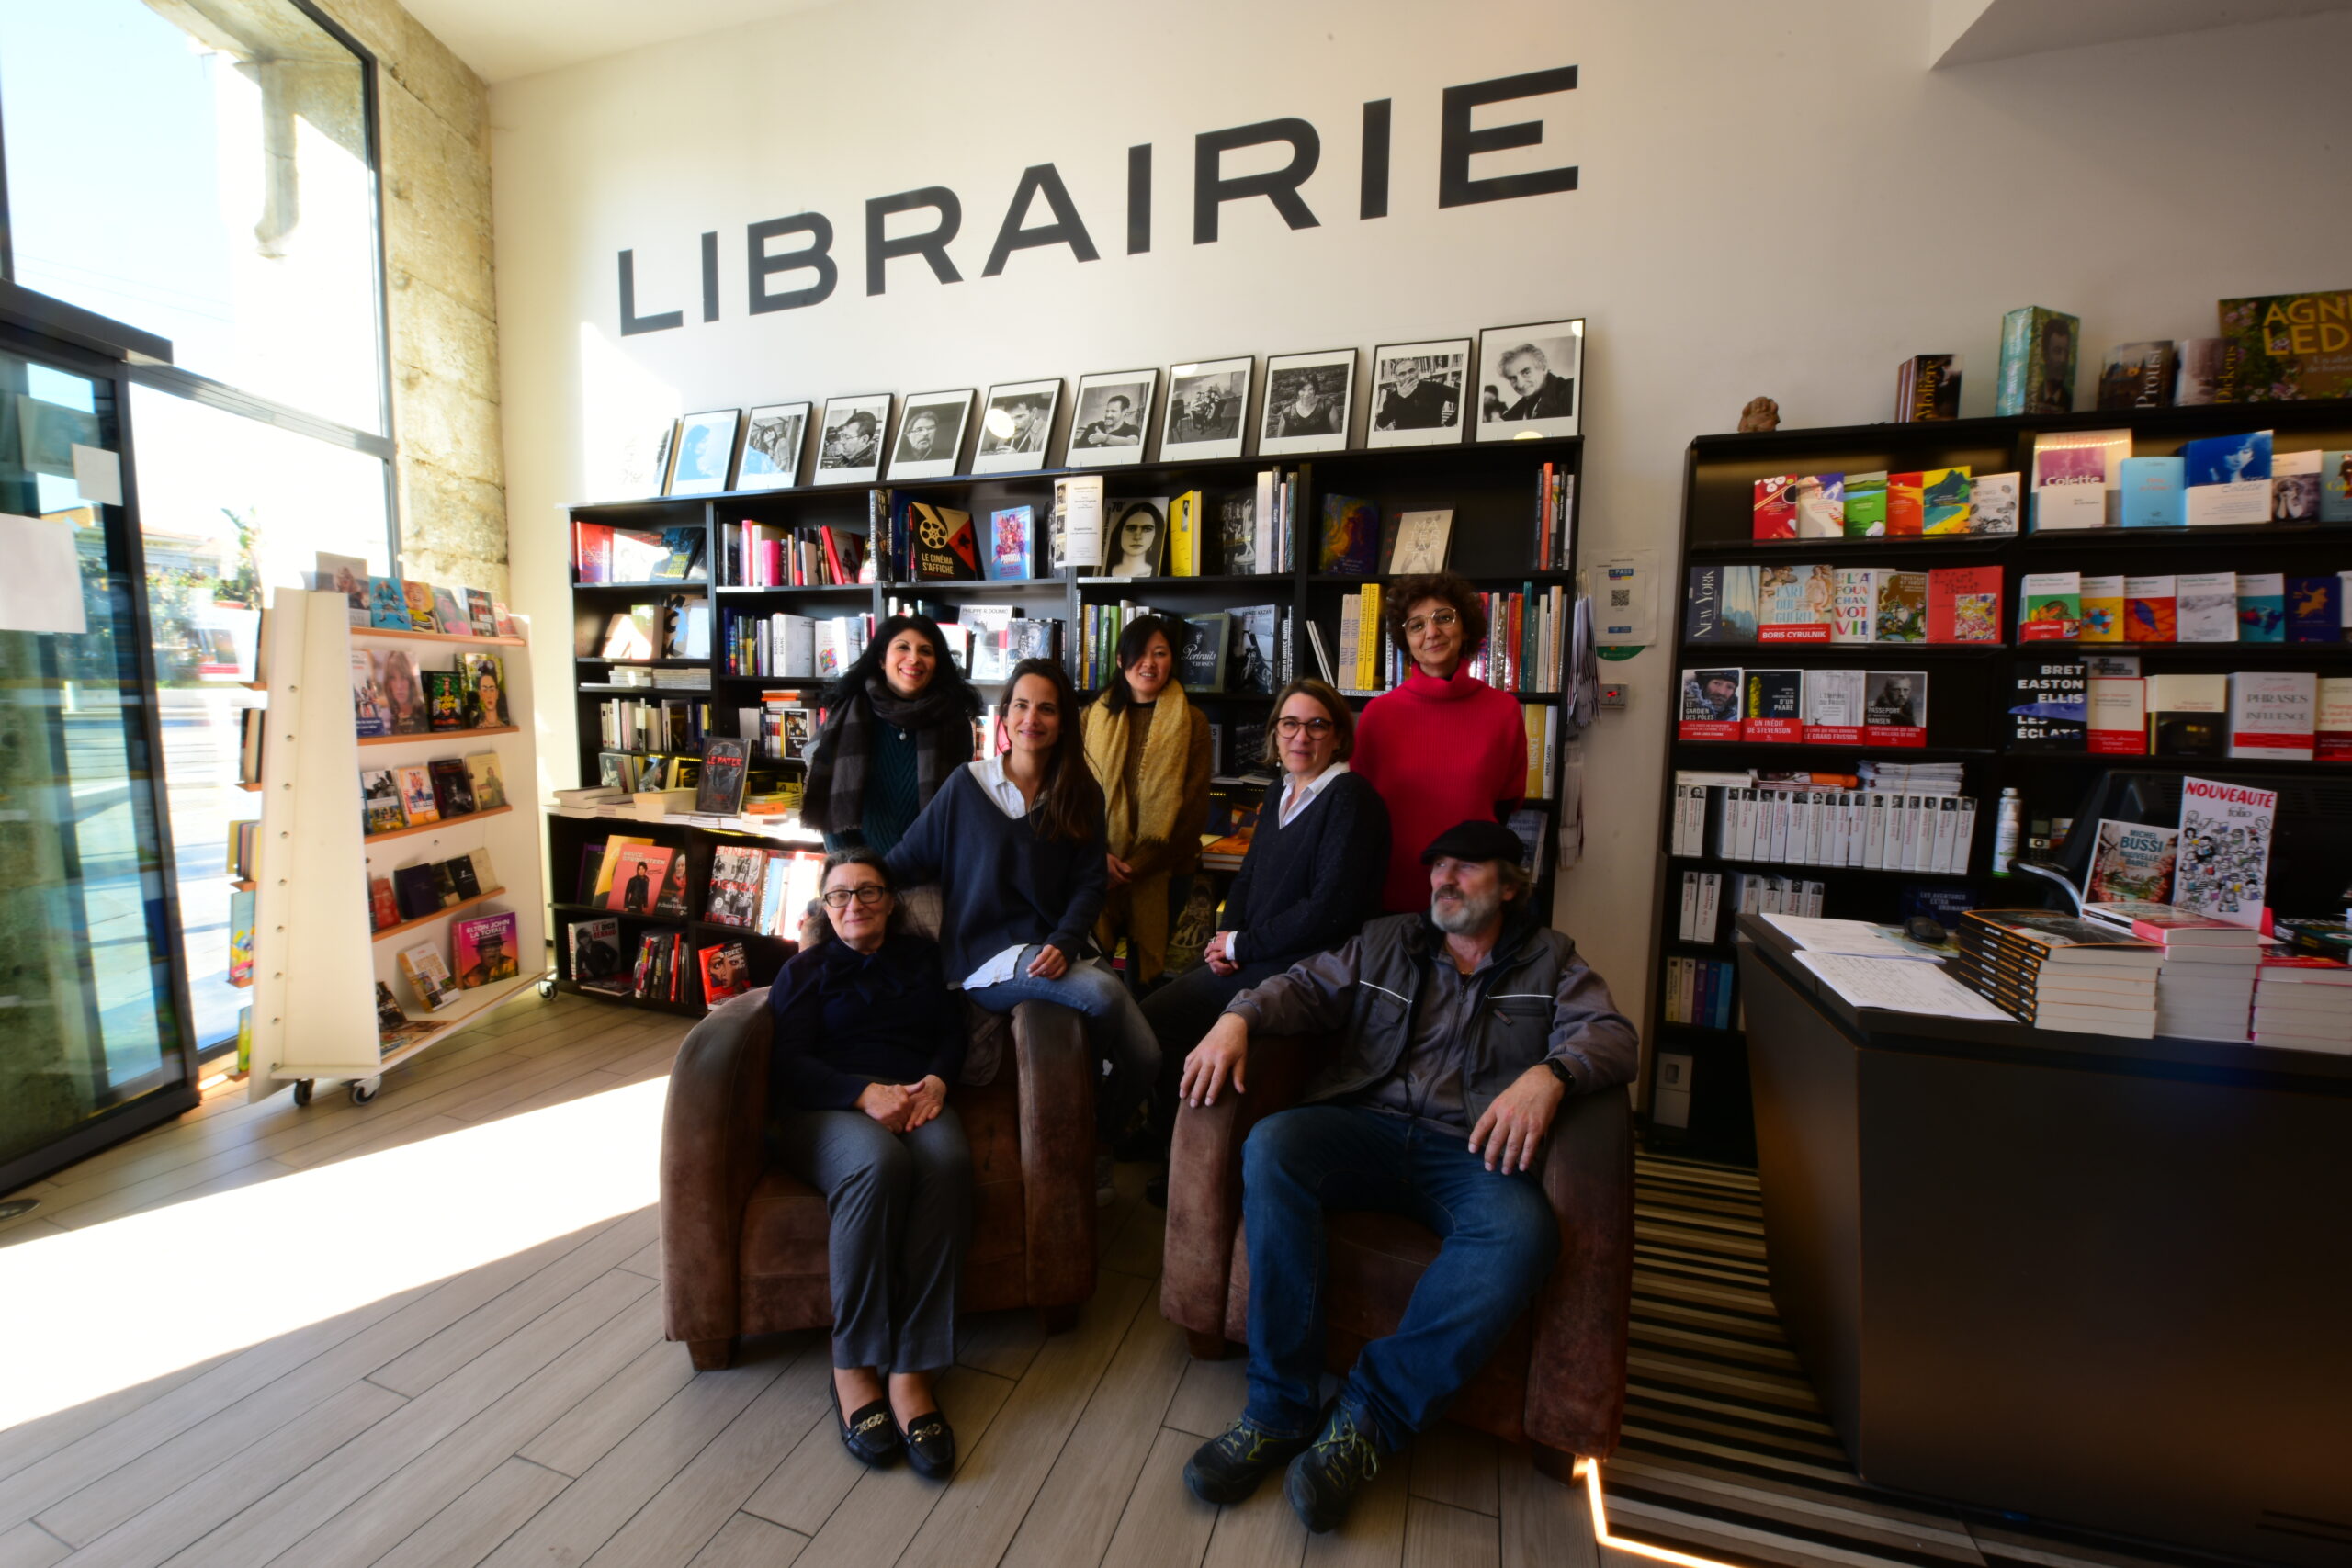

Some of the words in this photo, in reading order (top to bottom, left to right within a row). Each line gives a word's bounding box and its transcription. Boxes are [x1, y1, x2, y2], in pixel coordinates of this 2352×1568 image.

[617, 64, 1579, 337] LIBRAIRIE
[2263, 292, 2352, 327] AGN
[2135, 349, 2163, 408] Proust
[2214, 345, 2237, 404] Dickens
[2046, 474, 2101, 486] Colette
[922, 552, 929, 562] LE
[930, 553, 953, 565] CINÉMA
[922, 562, 954, 575] S'AFFICHE
[1695, 570, 1715, 604] YORK
[1693, 609, 1713, 637] NEW
[1762, 631, 1785, 639] BORIS
[1787, 630, 1826, 639] CYRULNIK
[1182, 643, 1216, 660] Portraits
[2041, 665, 2085, 675] BRET
[2017, 679, 2085, 690] EASTON
[2037, 693, 2085, 704] ELLIS
[2246, 694, 2309, 704] PHRASES
[2245, 711, 2307, 721] INFLUENCE
[1764, 719, 1785, 728] INÉDIT
[1757, 727, 1792, 735] STEVENSON
[1529, 736, 1540, 771] VERSACE
[707, 755, 716, 766] LE
[717, 756, 742, 766] PATER
[2185, 781, 2276, 809] NOUVEAUTÉ
[2228, 806, 2252, 818] folio
[2130, 829, 2157, 840] MICHEL
[2120, 836, 2164, 852] BUSSI
[622, 856, 666, 865] SPRINGSTEEN
[2120, 851, 2160, 863] NOUVELLE
[2125, 858, 2150, 868] BABEL
[709, 878, 758, 893] PIGNON
[1932, 892, 1966, 900] AVENTURES
[466, 922, 490, 934] ELTON
[490, 919, 511, 930] JOHN
[470, 931, 480, 939] LA
[481, 925, 508, 936] TOTALE
[720, 947, 743, 958] STREET
